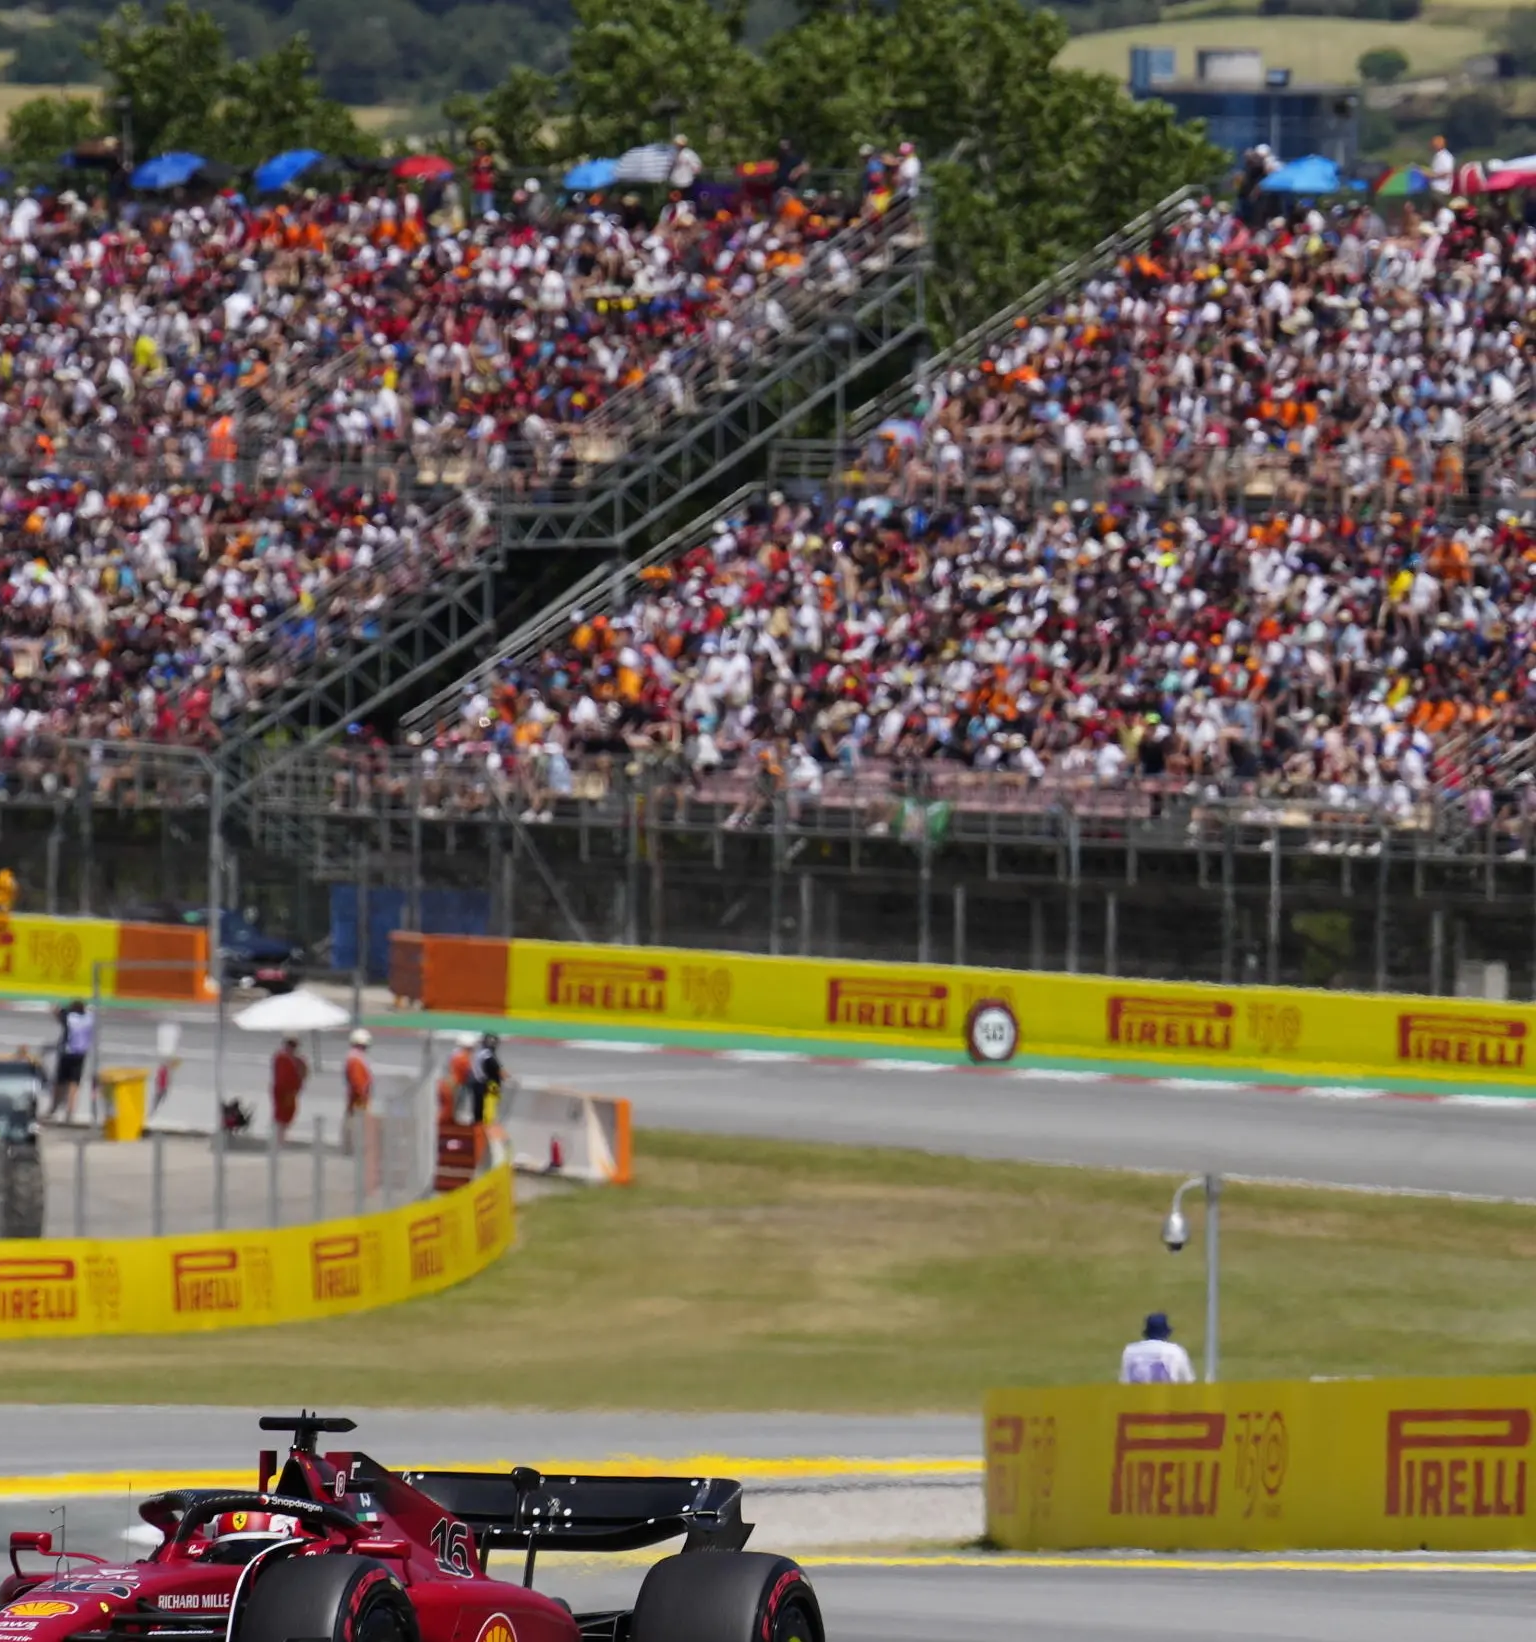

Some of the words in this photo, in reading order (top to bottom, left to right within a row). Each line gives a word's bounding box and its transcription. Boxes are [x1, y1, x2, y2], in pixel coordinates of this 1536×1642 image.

[547, 960, 667, 1012] PIRELLI
[827, 978, 948, 1030] PIRELLI
[1107, 996, 1234, 1051] PIRELLI
[1397, 1013, 1527, 1068] PIRELLI
[172, 1249, 242, 1312] PIRELLI
[311, 1235, 361, 1301] PIRELLI
[1109, 1412, 1226, 1516] PIRELLI
[1385, 1408, 1532, 1516] PIRELLI
[271, 1494, 323, 1512] Snapdragon
[430, 1517, 474, 1578] 16
[158, 1595, 199, 1609] RICHARD
[201, 1593, 230, 1608] MILLE
